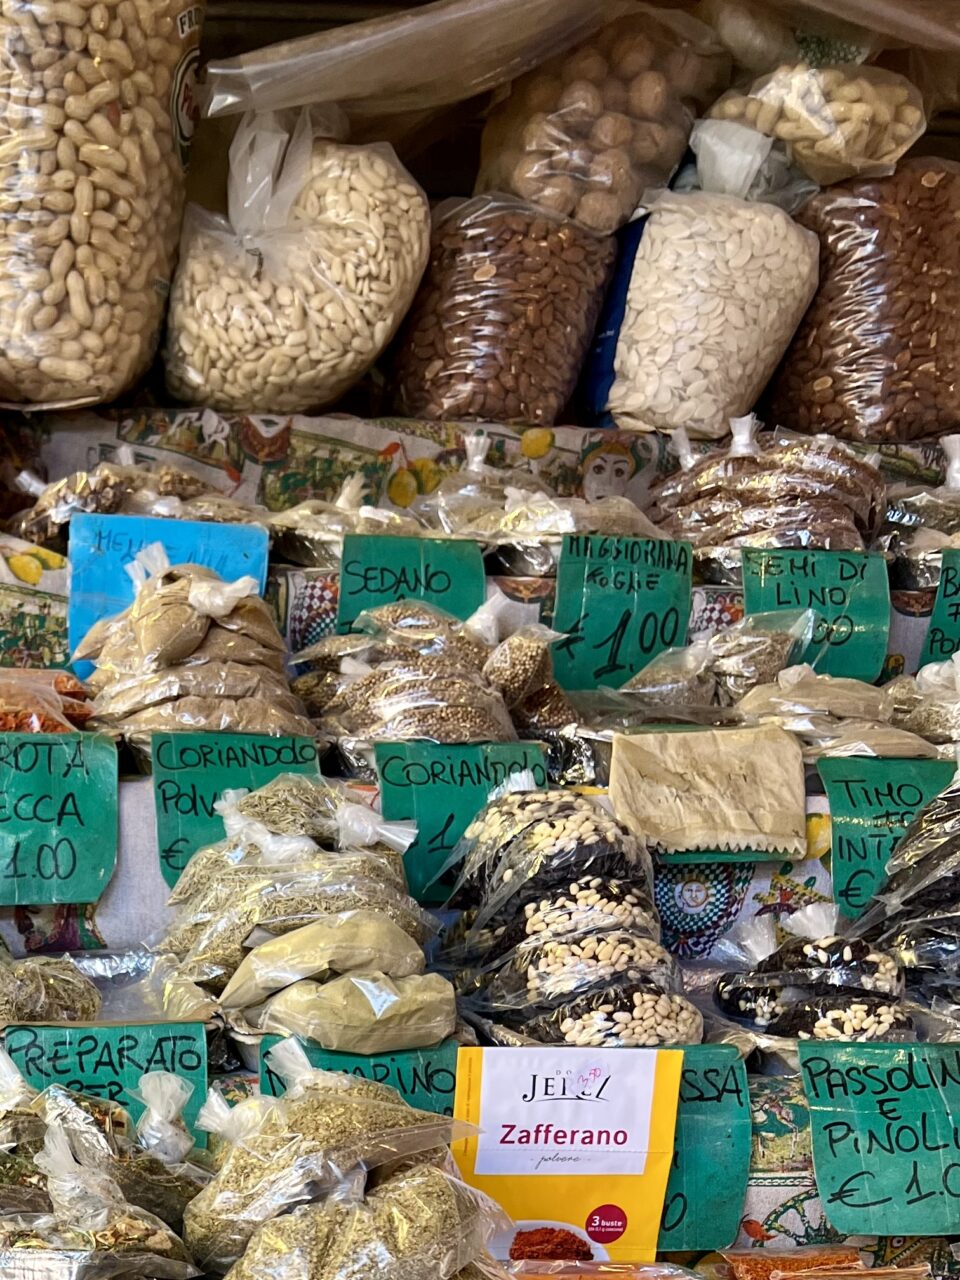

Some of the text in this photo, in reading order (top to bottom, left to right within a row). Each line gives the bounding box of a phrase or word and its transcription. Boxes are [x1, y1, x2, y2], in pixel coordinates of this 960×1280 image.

[344, 561, 451, 595] SEDANO
[838, 556, 869, 581] DI
[776, 581, 847, 607] LINO
[592, 607, 680, 680] 1.00
[156, 738, 317, 770] CORIANDOLO
[831, 779, 923, 808] TIMO
[3, 837, 77, 880] 1.00
[5, 1027, 203, 1078] PREPARATO
[876, 1097, 903, 1121] E
[499, 1123, 628, 1146] Zafferano
[827, 1170, 893, 1208] €
[591, 1215, 623, 1227] 3 buste
